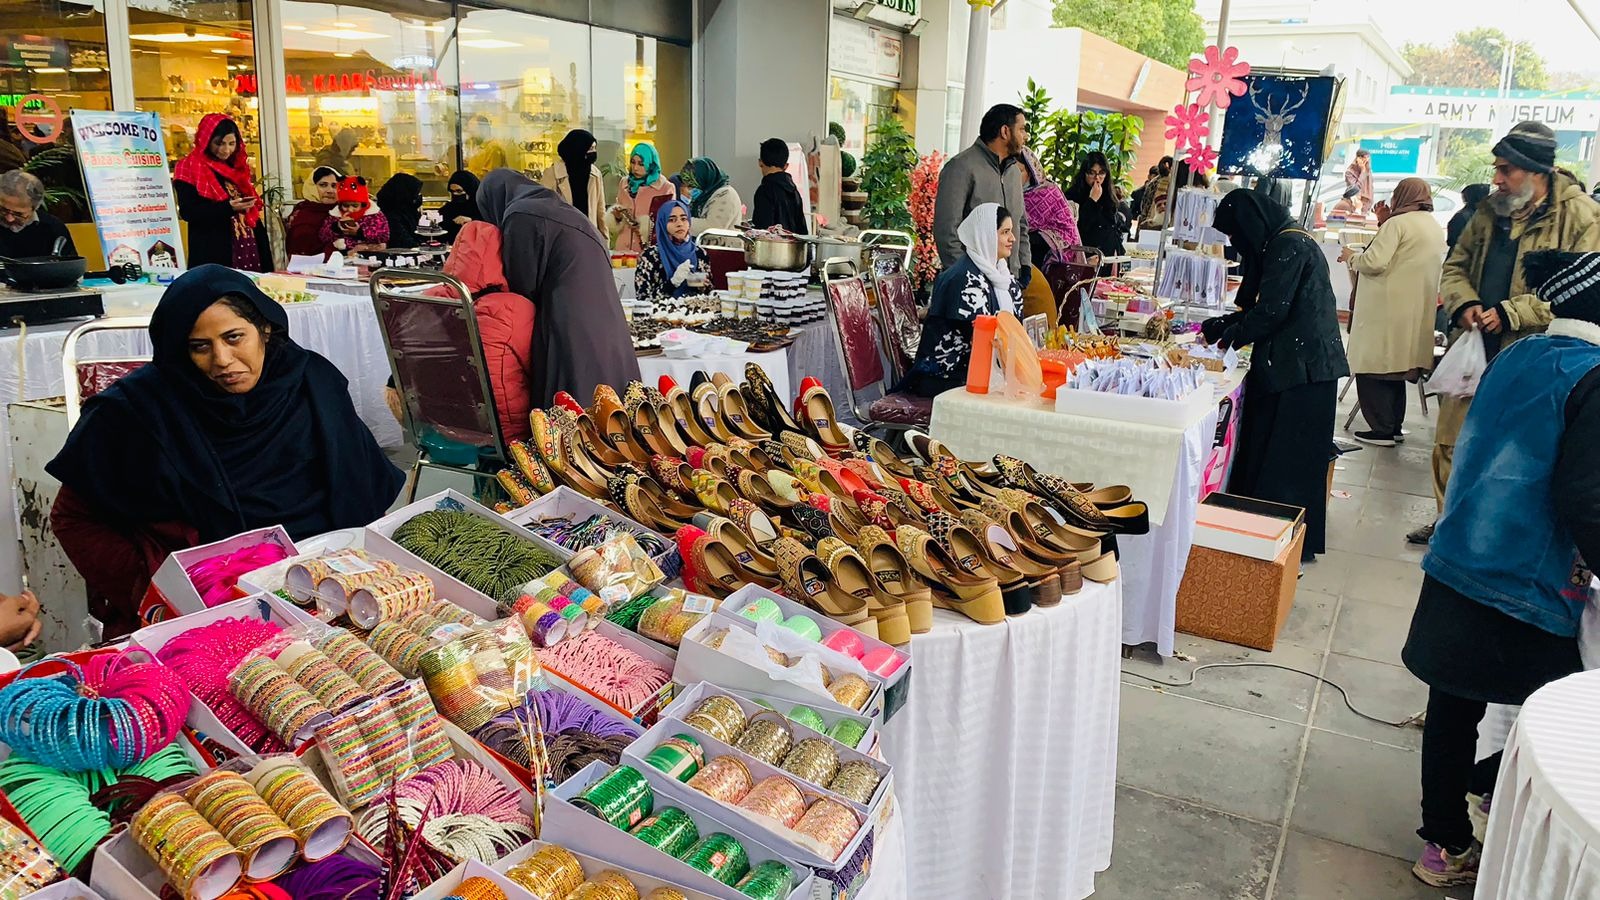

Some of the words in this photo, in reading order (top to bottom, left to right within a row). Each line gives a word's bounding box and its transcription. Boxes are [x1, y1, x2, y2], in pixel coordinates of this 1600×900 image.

[1425, 102, 1477, 121] ARMY
[78, 122, 139, 141] WELCOME
[141, 127, 158, 142] TO
[123, 149, 162, 166] Cuisine
[147, 226, 171, 235] Available
